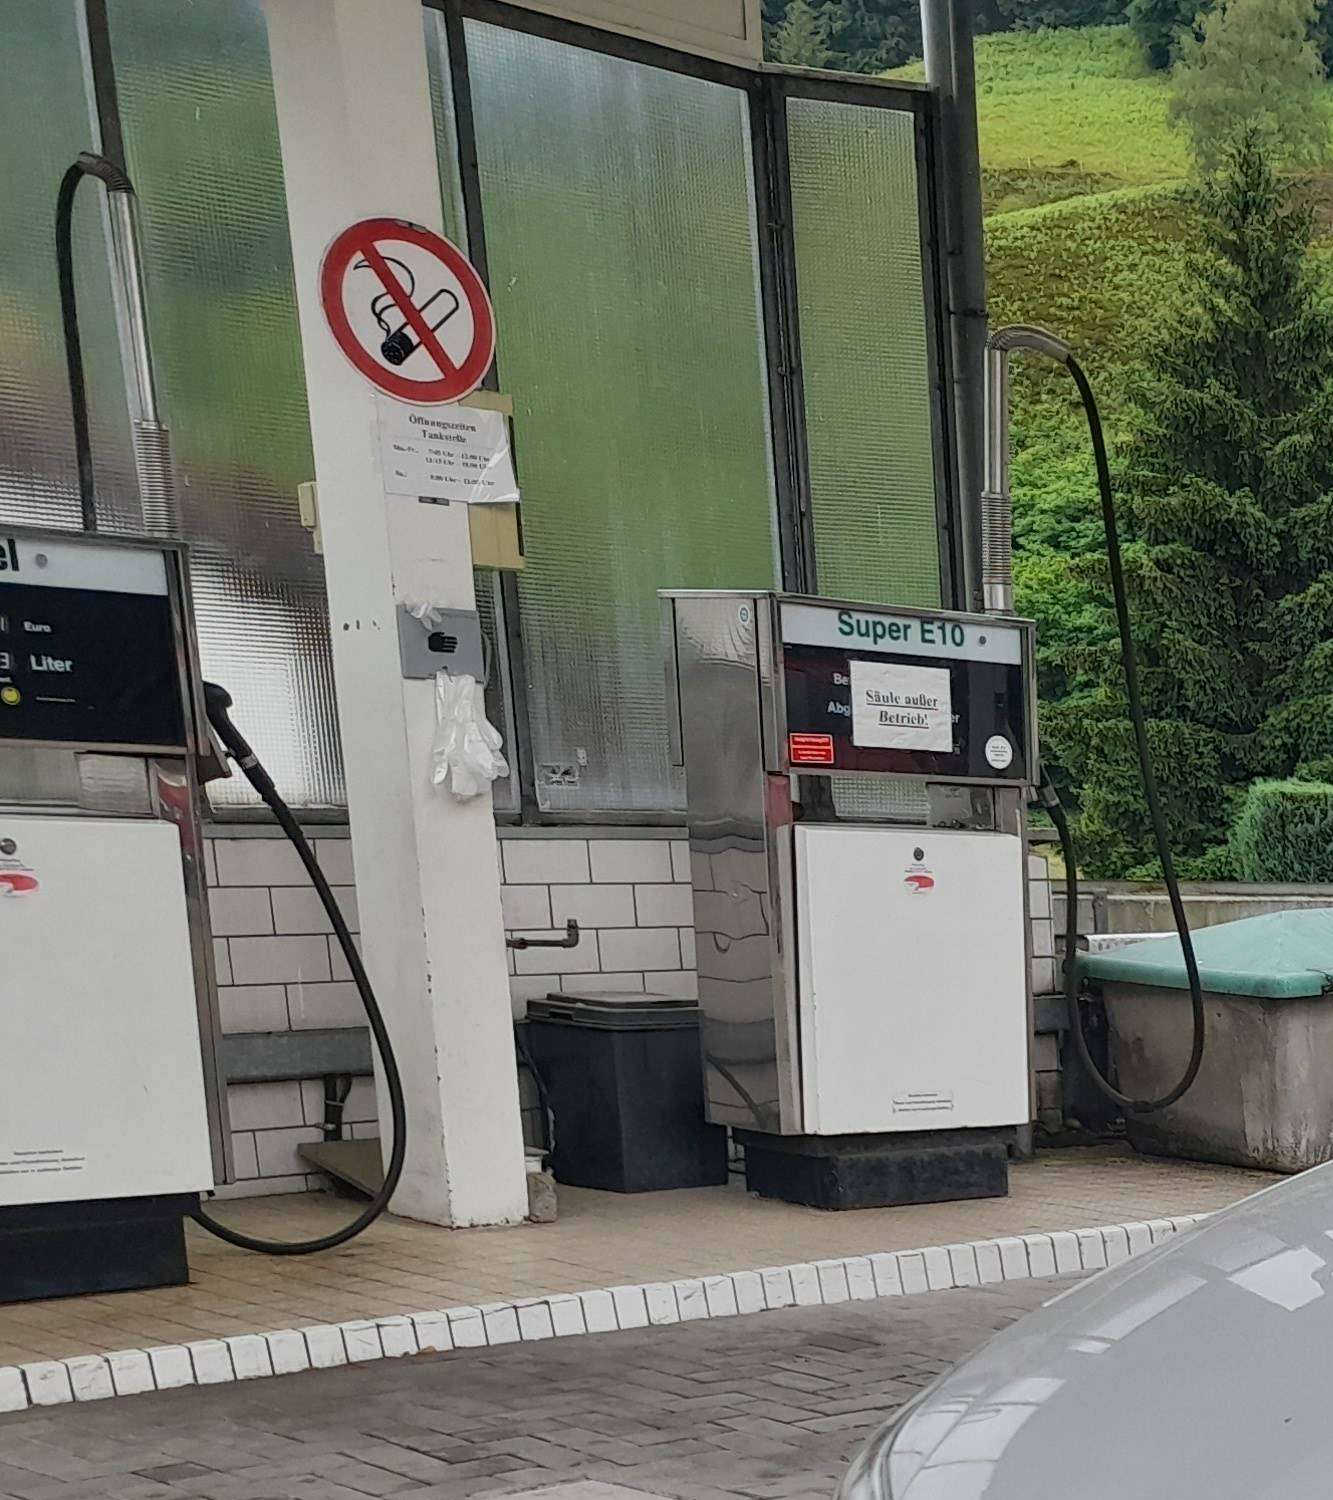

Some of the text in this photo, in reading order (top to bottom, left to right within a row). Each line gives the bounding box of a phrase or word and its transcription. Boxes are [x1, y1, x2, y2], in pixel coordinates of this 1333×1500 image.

[23, 620, 52, 633] Euro
[837, 610, 965, 647] Super E10
[30, 653, 73, 673] Liter
[865, 689, 938, 708] Säule außer
[878, 710, 928, 726] Betrieb!
